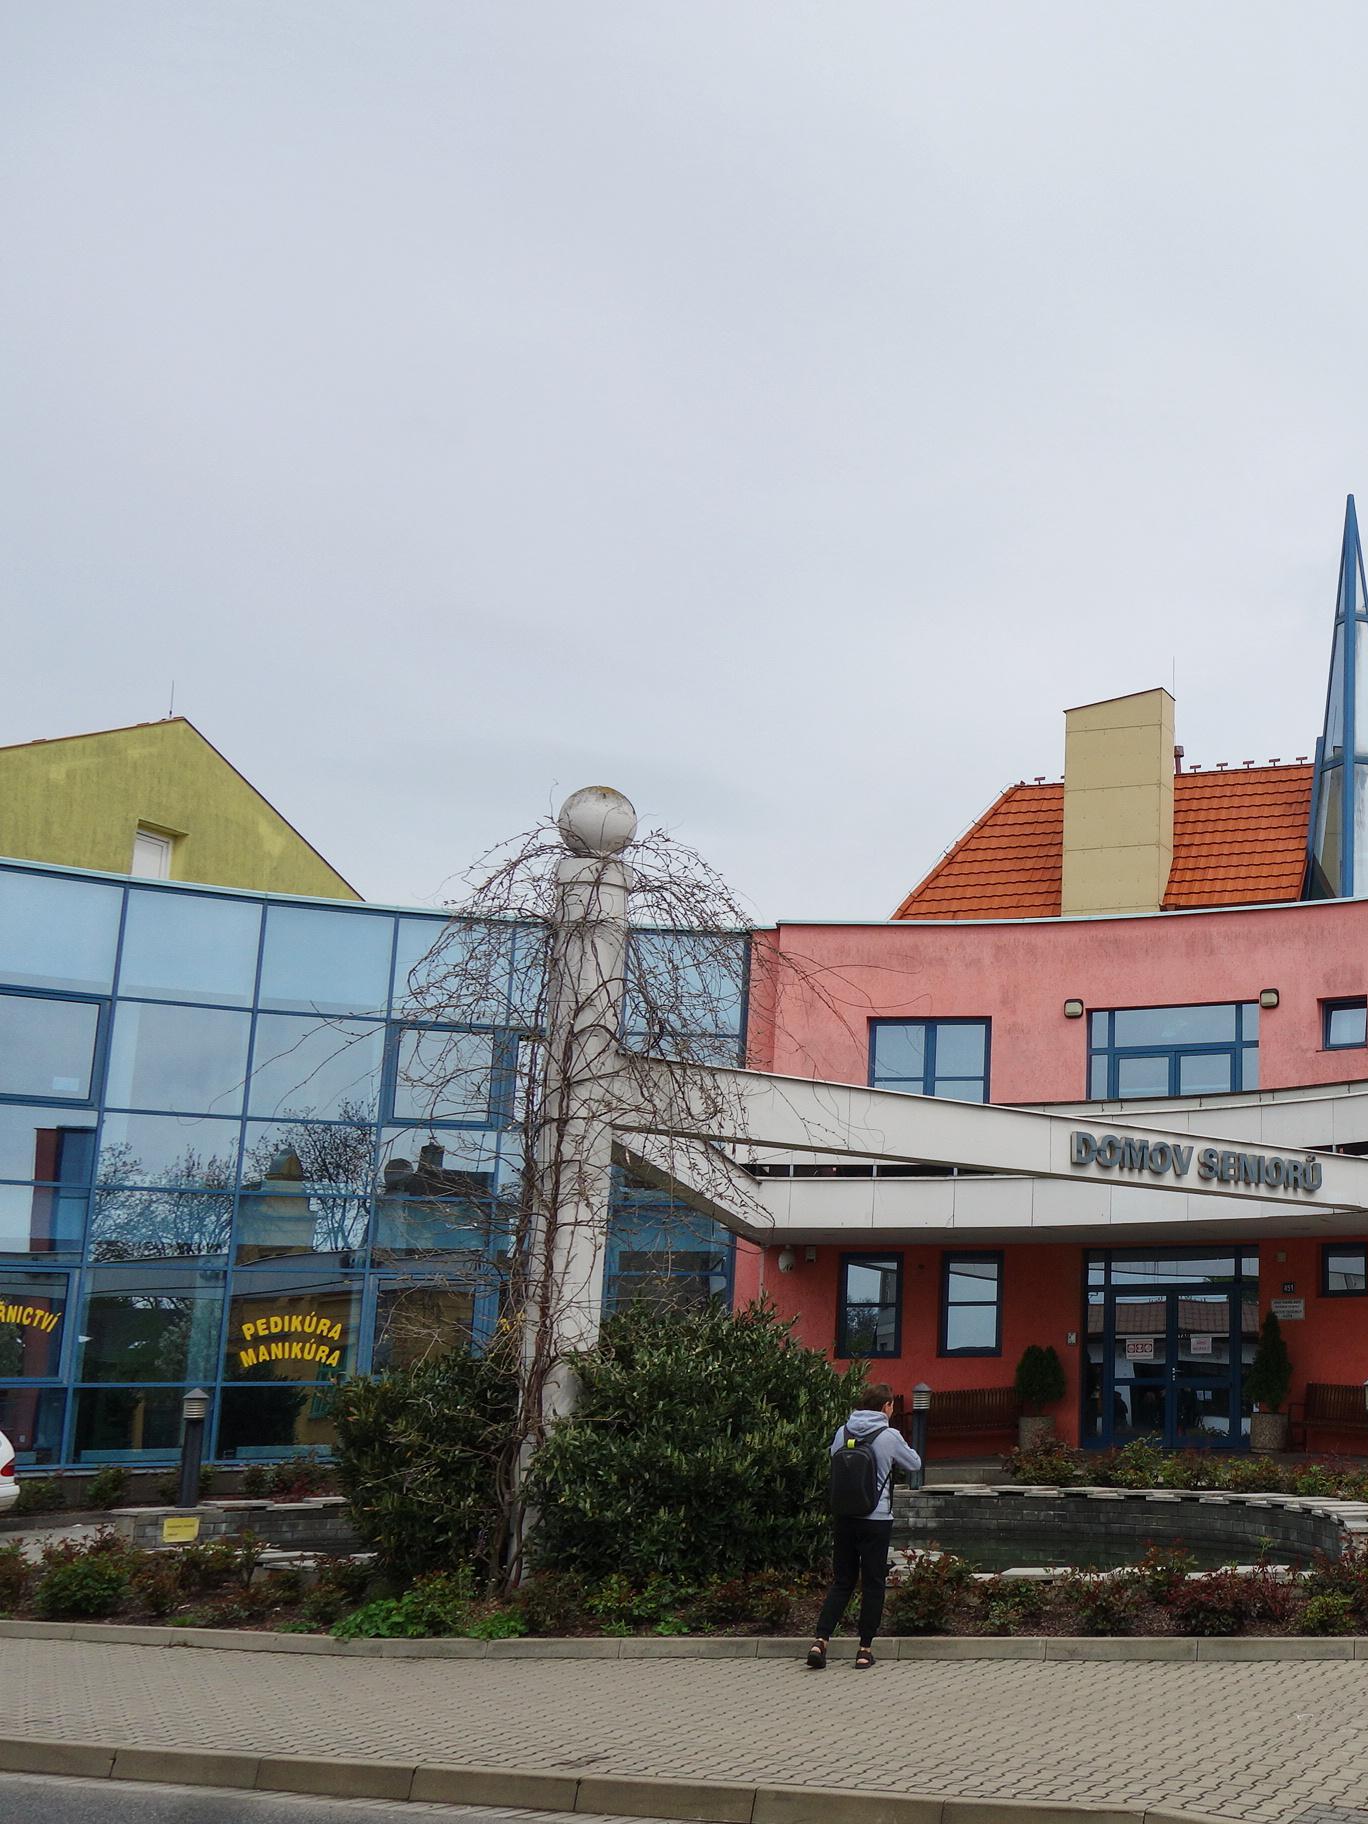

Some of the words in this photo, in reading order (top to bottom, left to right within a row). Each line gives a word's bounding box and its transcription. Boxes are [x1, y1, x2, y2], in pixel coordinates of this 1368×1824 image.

[1071, 1131, 1194, 1176] DOMOV
[1198, 1148, 1322, 1191] SENIORŮ
[241, 1311, 342, 1341] PEDIKÚRA
[240, 1338, 341, 1367] MANIKÚRA
